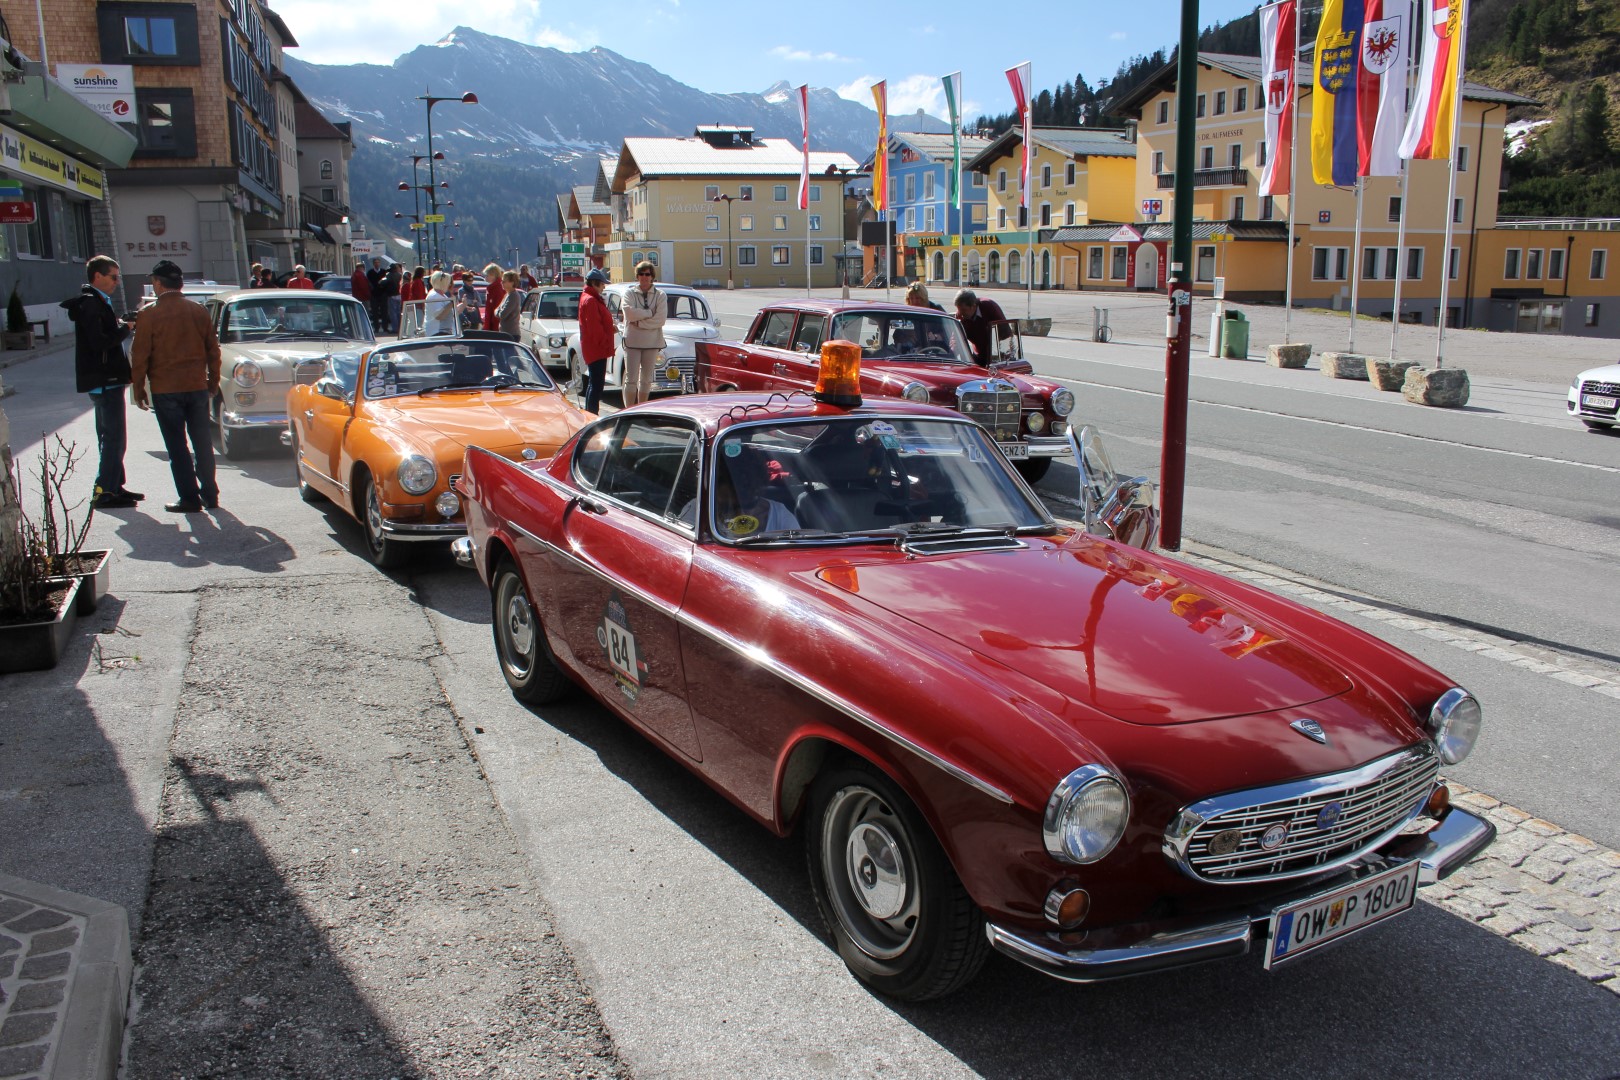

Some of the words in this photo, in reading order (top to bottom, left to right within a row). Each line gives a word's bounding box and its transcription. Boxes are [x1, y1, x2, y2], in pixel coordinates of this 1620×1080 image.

[74, 74, 118, 86] sunshine
[1212, 129, 1244, 139] AUFMESSER
[666, 202, 715, 213] WAGNER
[918, 237, 940, 246] SPORT
[972, 234, 998, 245] ERIKA
[125, 241, 193, 252] PERNER
[1021, 445, 1027, 456] 3
[611, 627, 630, 672] 84
[1295, 906, 1329, 943] OW
[1342, 895, 1358, 926] P
[1364, 874, 1409, 917] 1800
[1278, 939, 1286, 949] A
